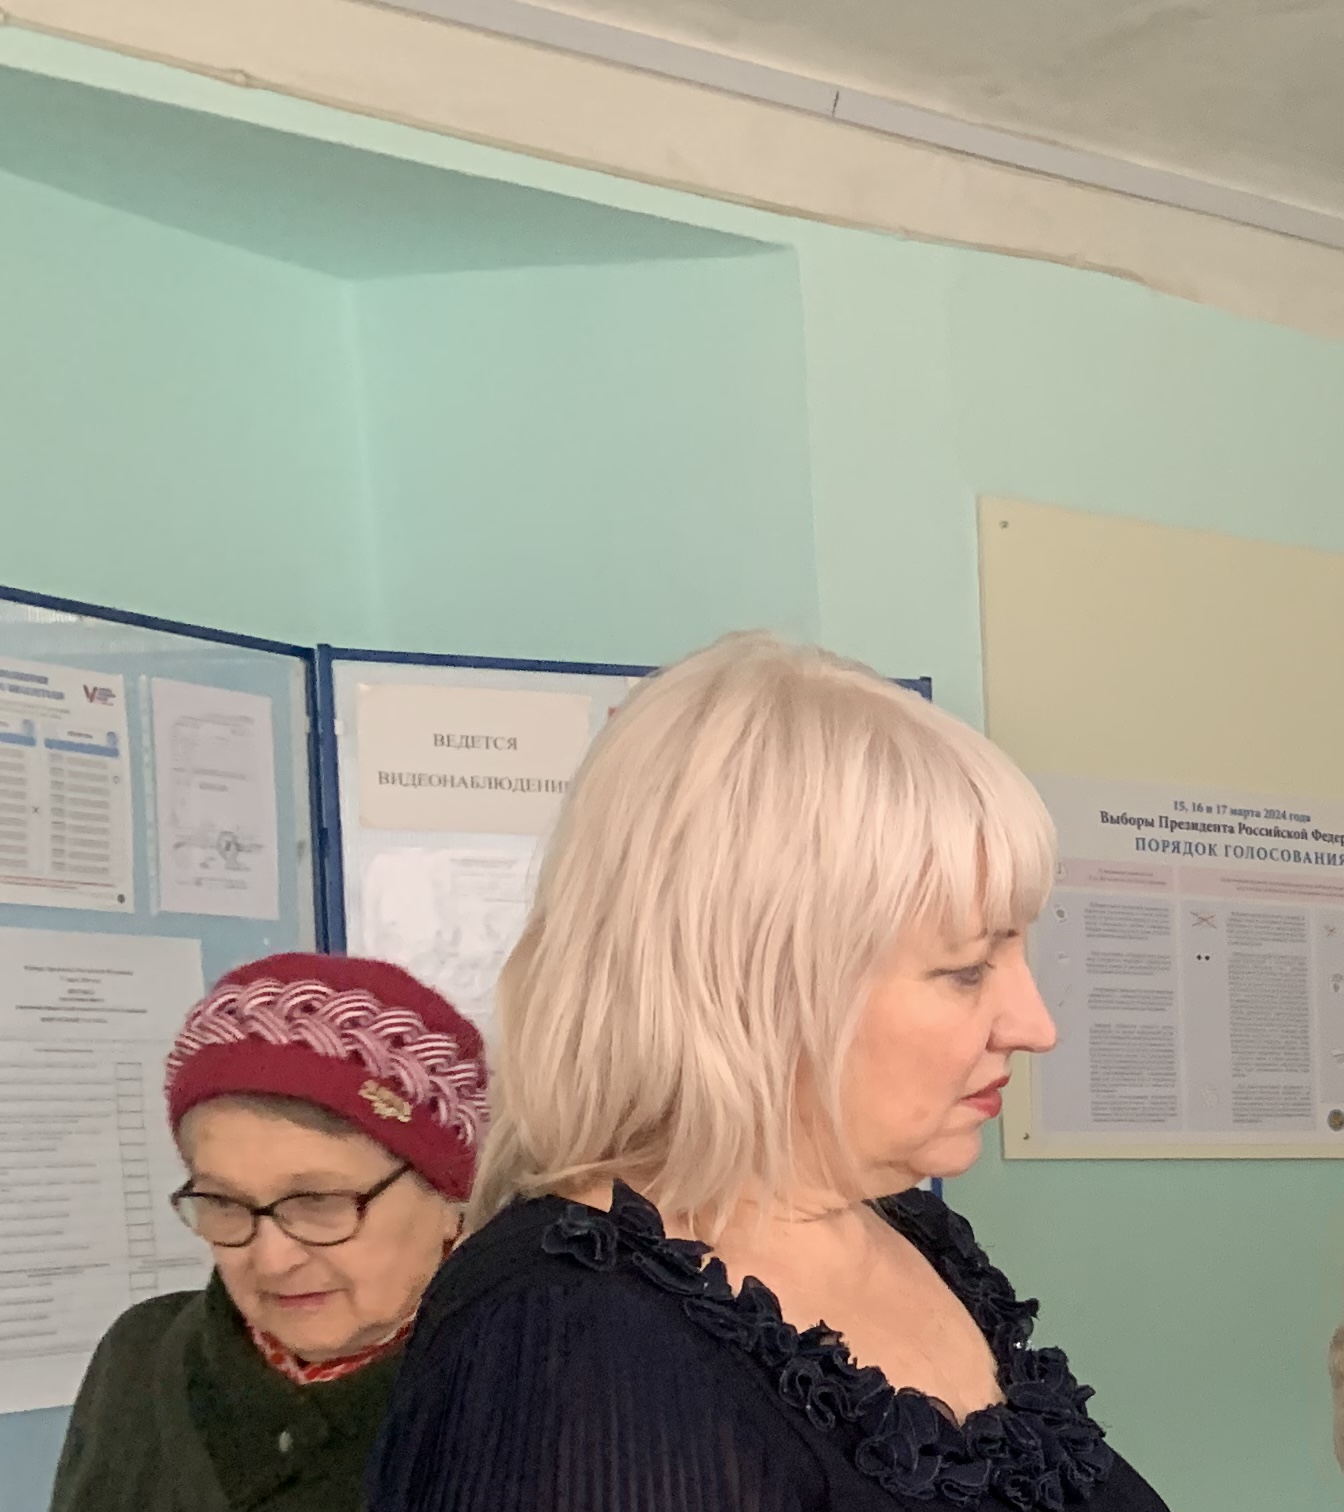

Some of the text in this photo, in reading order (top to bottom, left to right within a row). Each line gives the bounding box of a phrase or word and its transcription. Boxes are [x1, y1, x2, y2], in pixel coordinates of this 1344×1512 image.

[433, 732, 518, 751] ВЕДЕТСЯ
[1192, 802, 1203, 813] 16
[1216, 803, 1228, 815] 17
[1230, 807, 1261, 820] марта
[1263, 808, 1287, 820] 2024
[1099, 810, 1155, 830] Выборы
[1158, 815, 1235, 834] Президента
[1238, 822, 1308, 840] Российской
[1135, 837, 1219, 858] ПОРЯДОК
